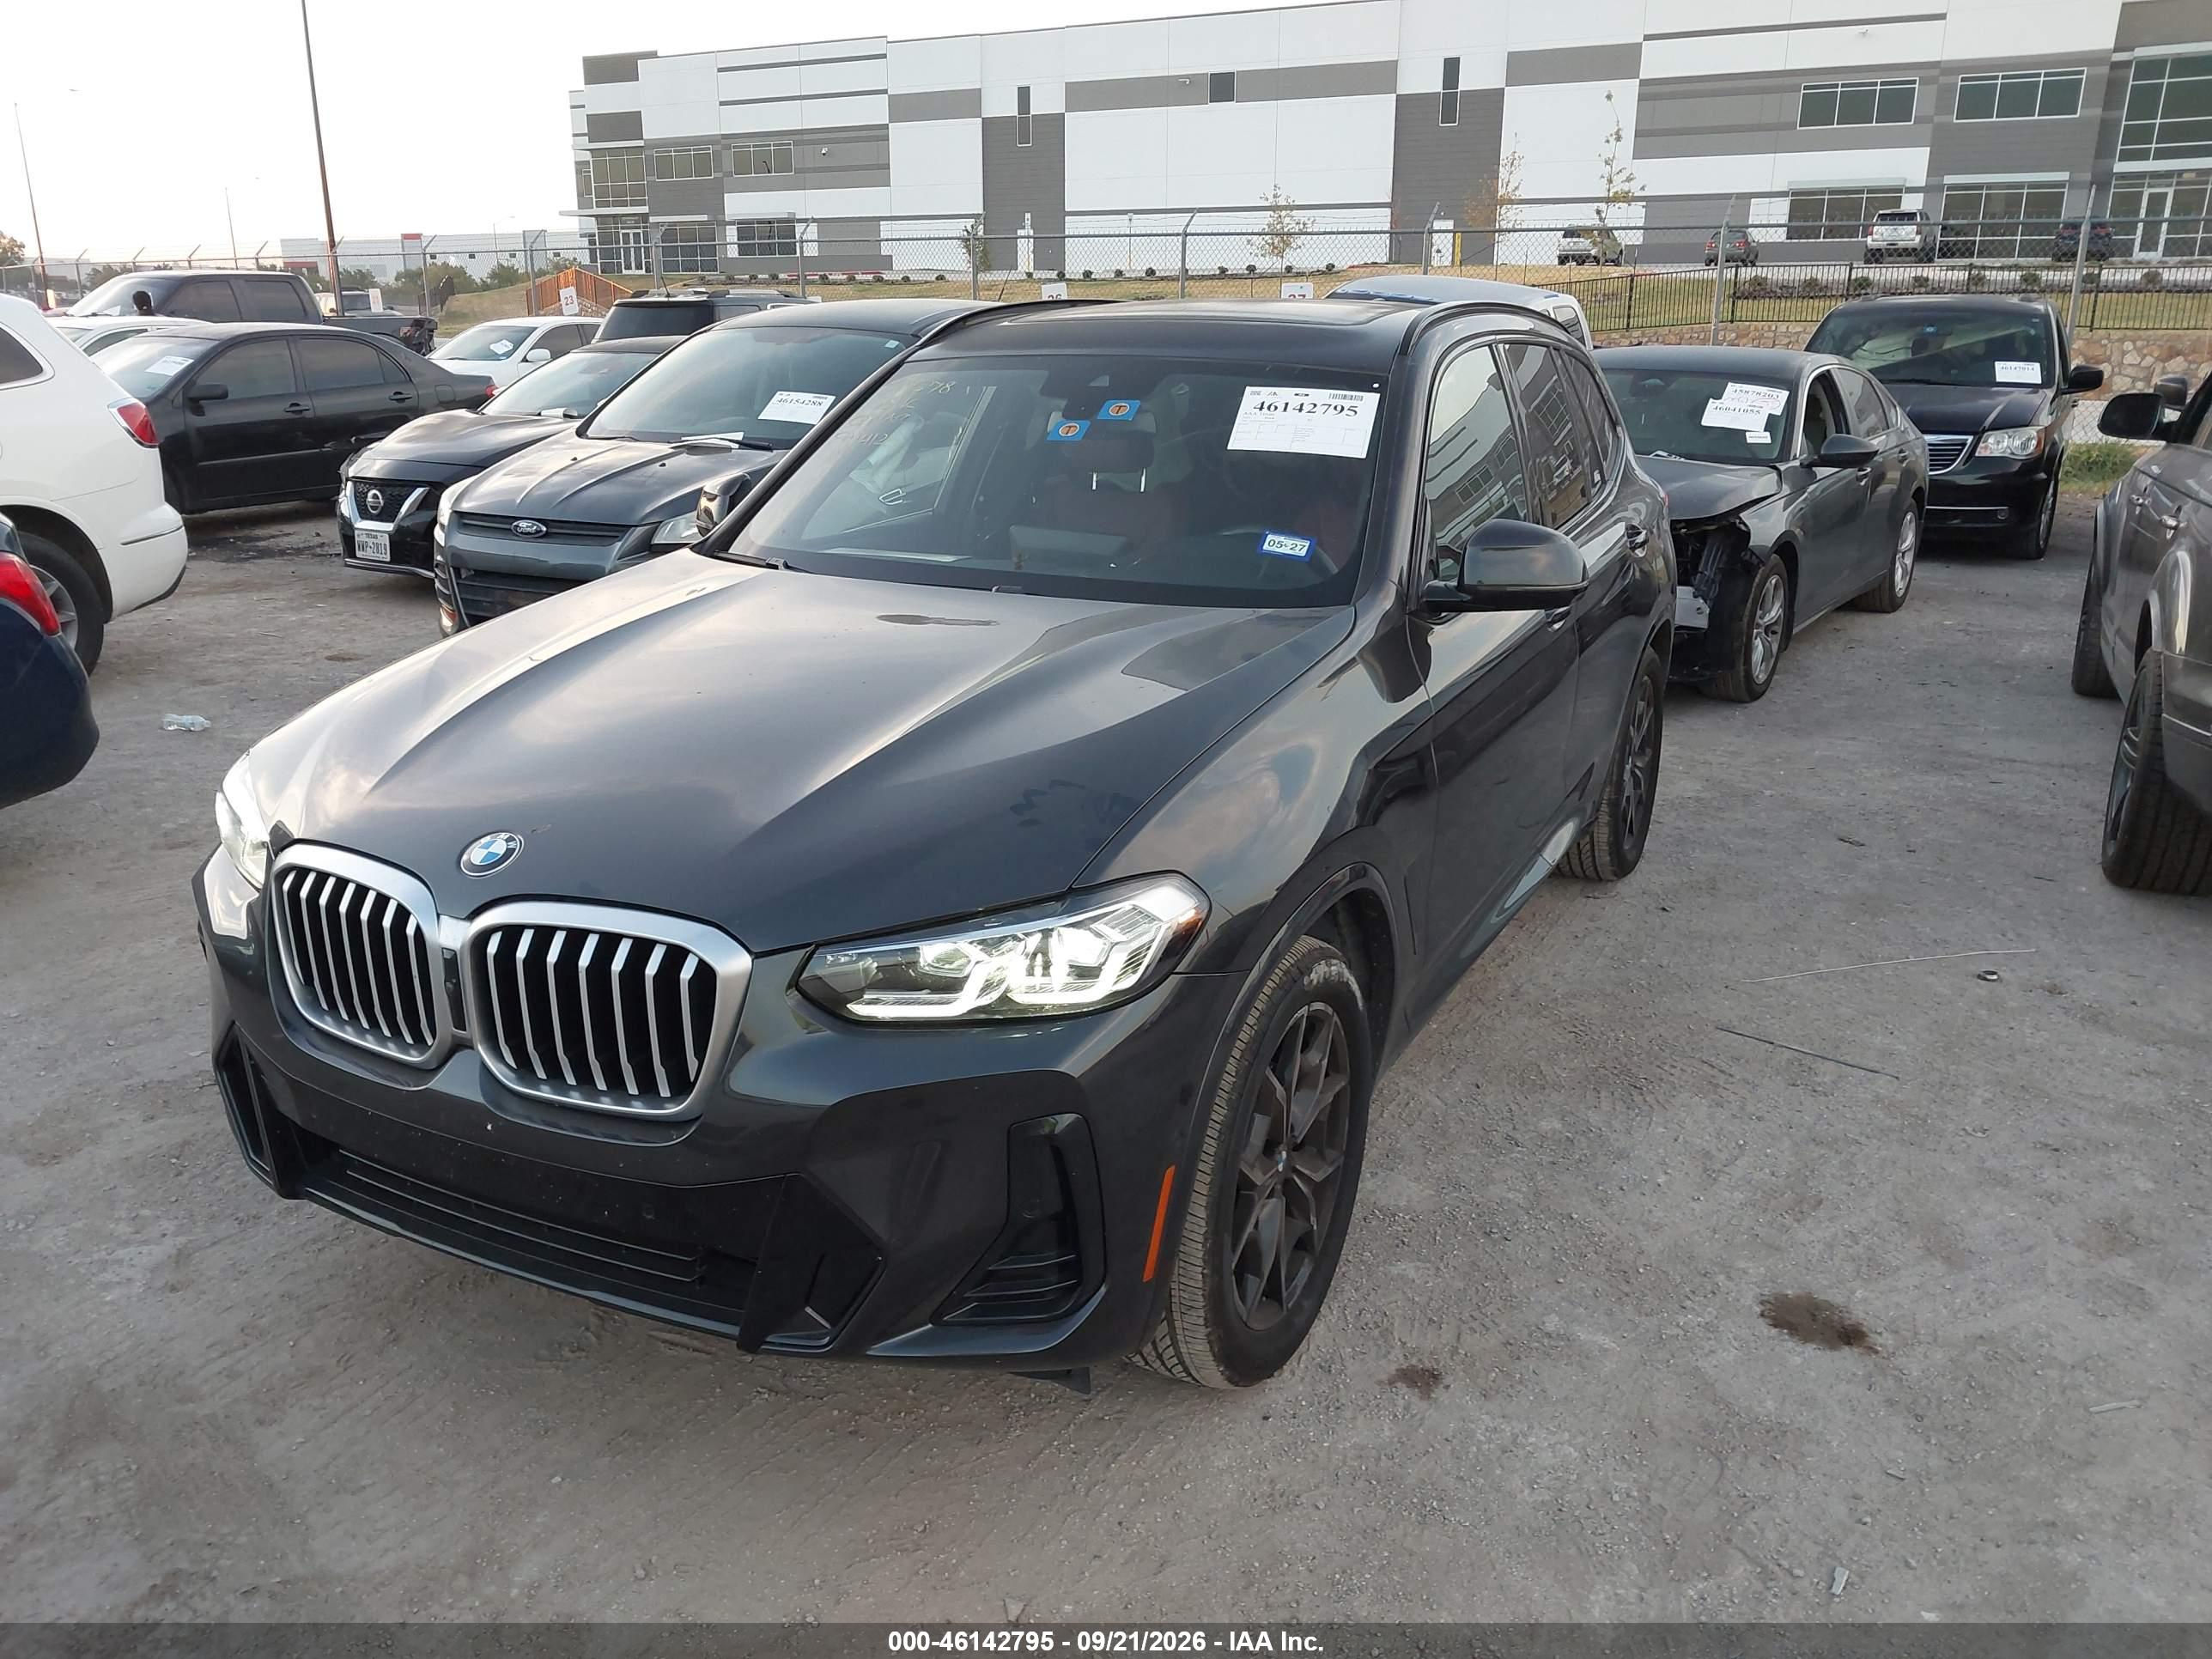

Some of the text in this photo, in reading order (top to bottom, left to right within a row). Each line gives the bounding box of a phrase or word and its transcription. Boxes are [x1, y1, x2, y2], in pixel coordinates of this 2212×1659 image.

[563, 295, 574, 306] 23
[1252, 400, 1359, 417] 46142795
[517, 522, 537, 533] Ford
